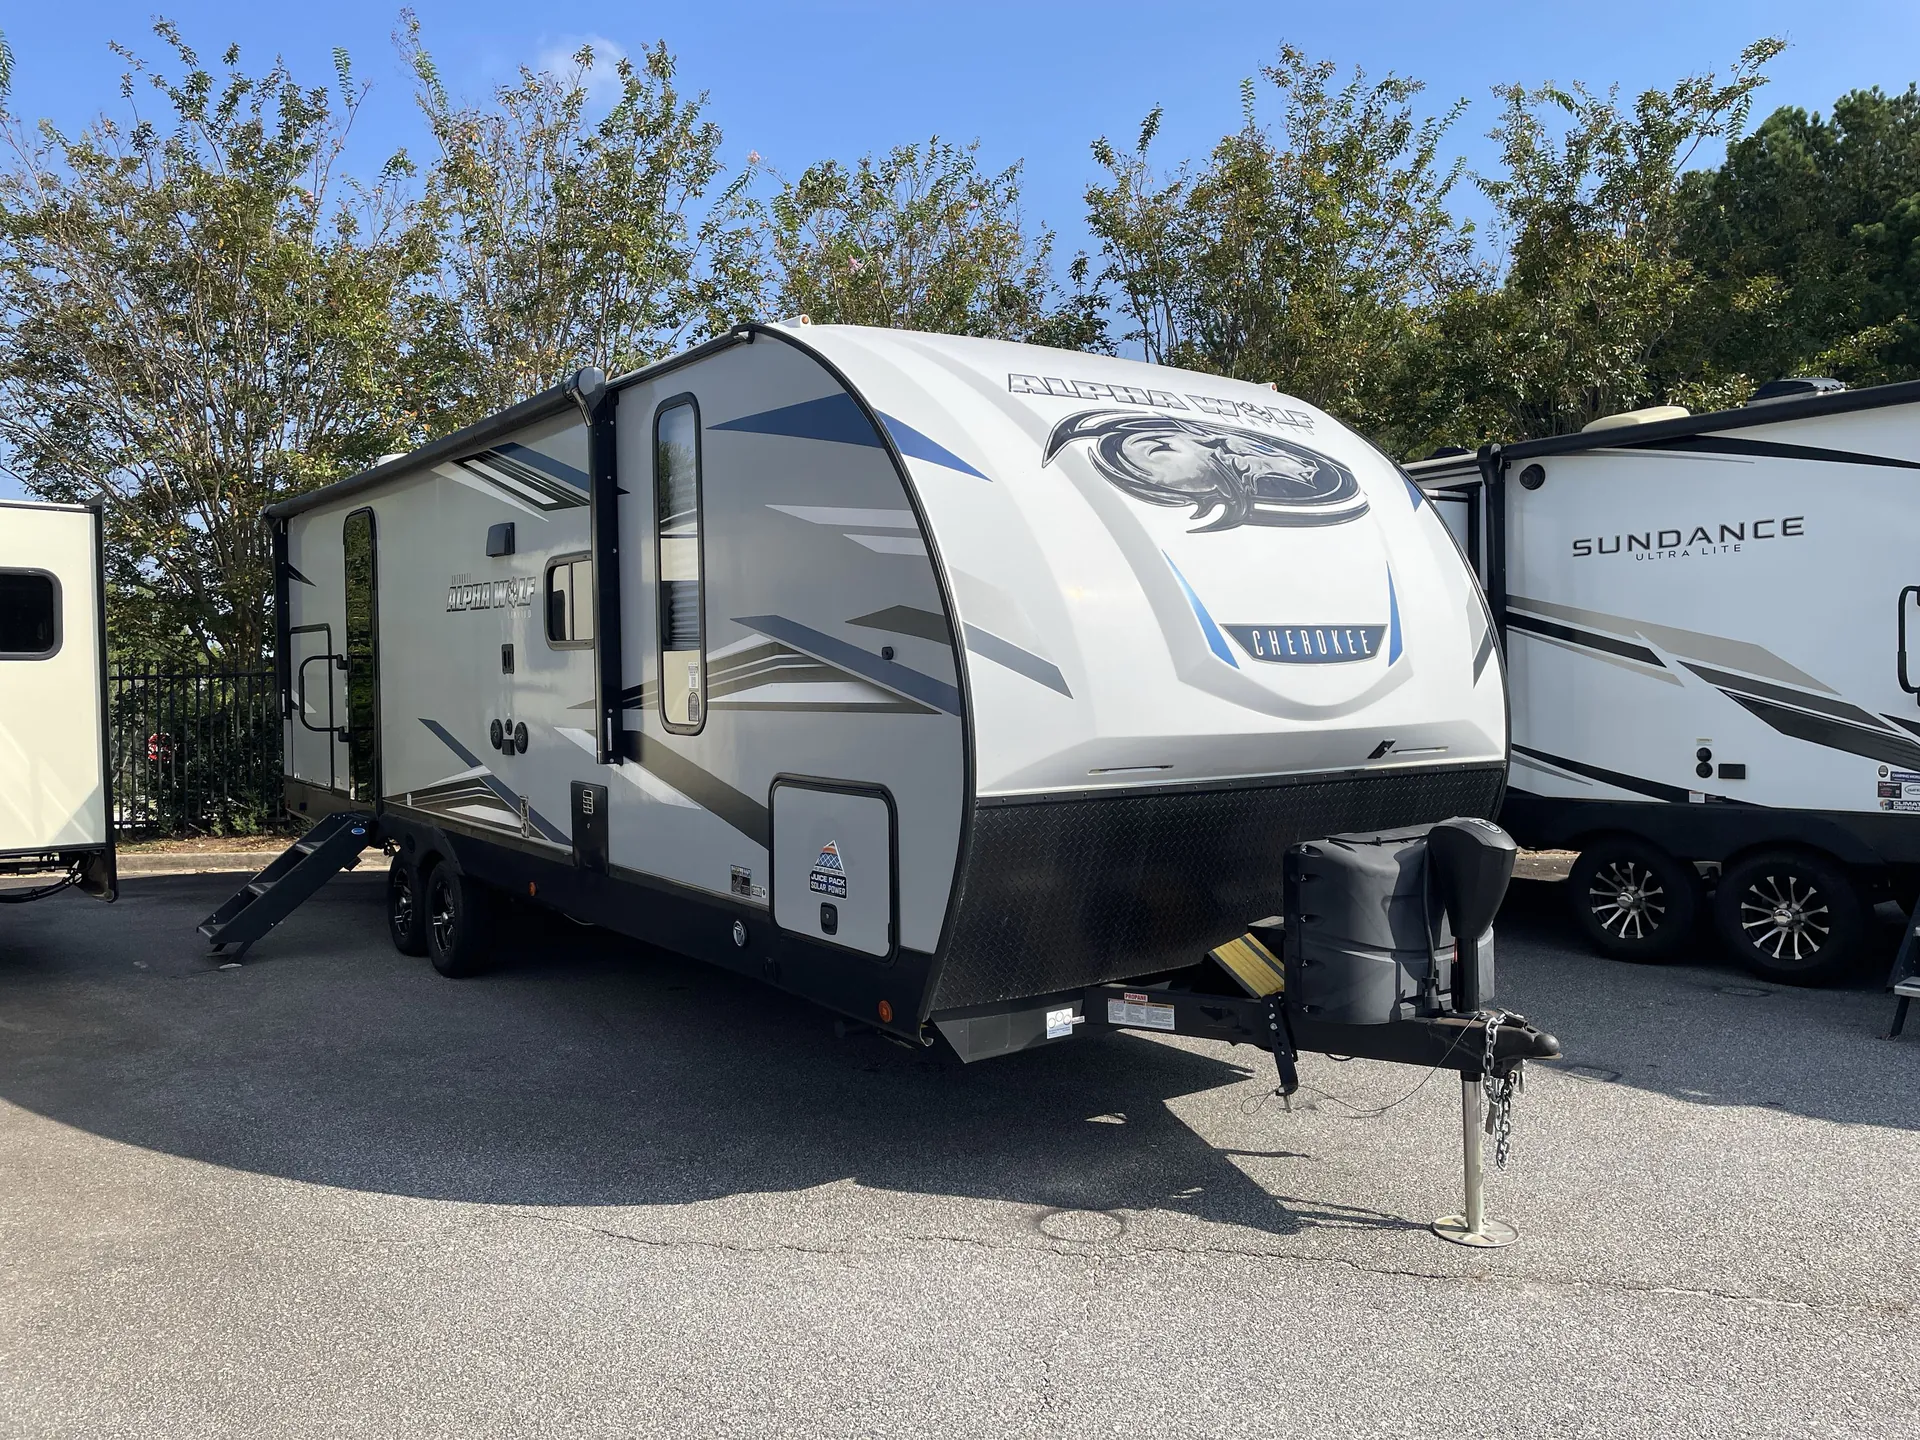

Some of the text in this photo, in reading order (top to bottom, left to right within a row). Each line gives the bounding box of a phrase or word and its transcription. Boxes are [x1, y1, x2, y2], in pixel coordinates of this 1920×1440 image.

[1008, 373, 1191, 412] ALPHA
[1572, 516, 1805, 557] SUNDANCE
[1635, 544, 1741, 561] ULTRA LITE
[446, 582, 491, 612] ALPHA
[1252, 630, 1371, 656] CHEROKEE
[811, 874, 845, 886] JUICE PACK
[811, 881, 845, 895] SOLAR POWER
